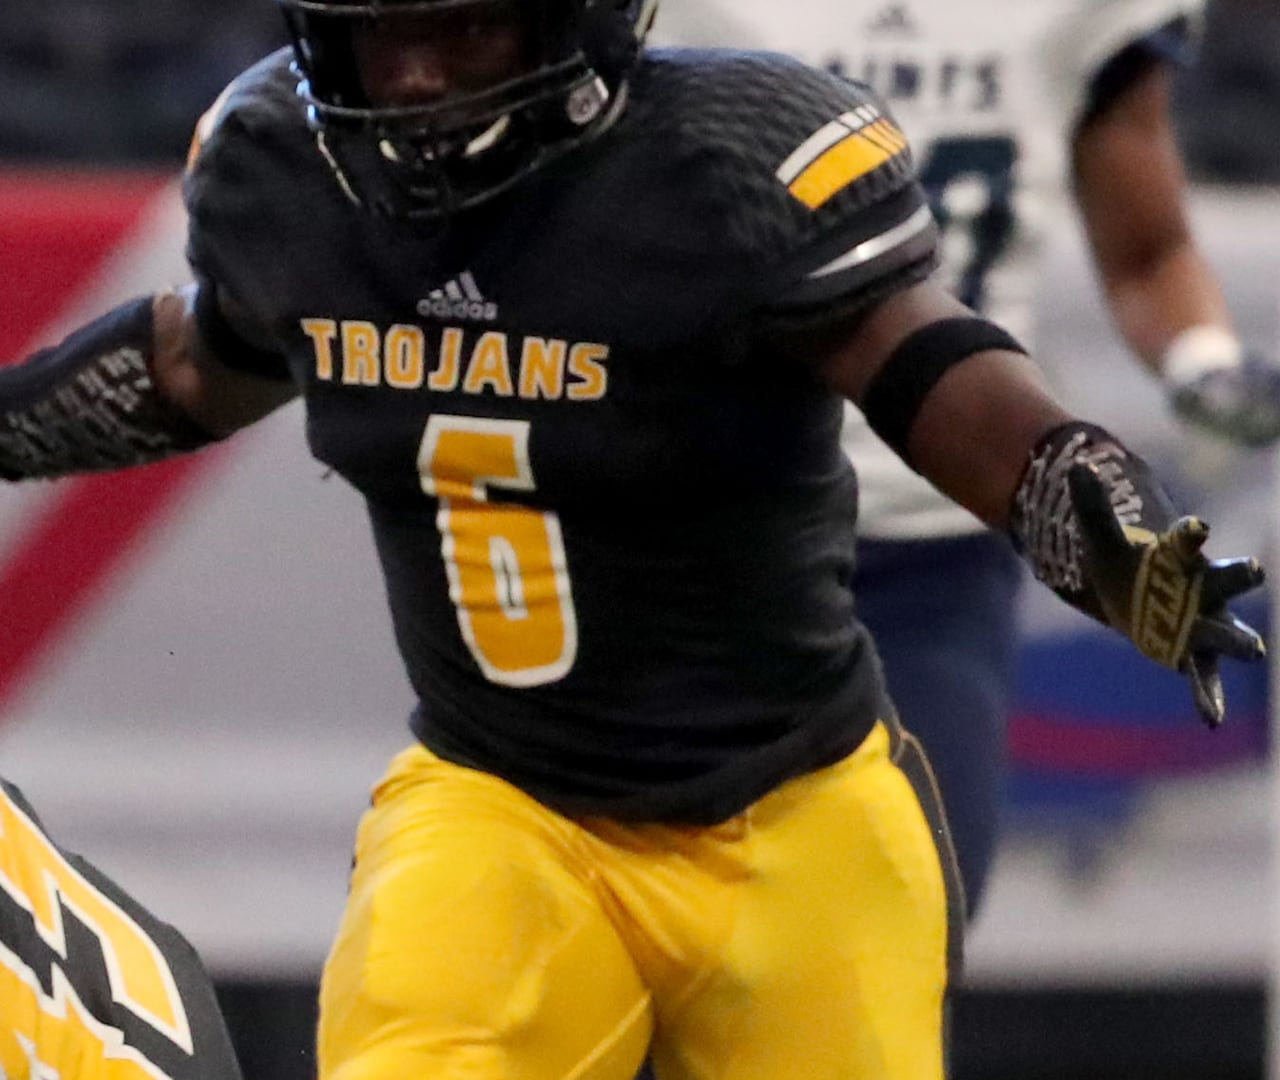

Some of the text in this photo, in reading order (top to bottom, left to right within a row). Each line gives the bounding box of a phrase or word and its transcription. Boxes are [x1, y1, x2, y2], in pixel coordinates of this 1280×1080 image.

[416, 299, 498, 320] adidas
[300, 317, 610, 401] TROJANS
[416, 413, 580, 688] 6
